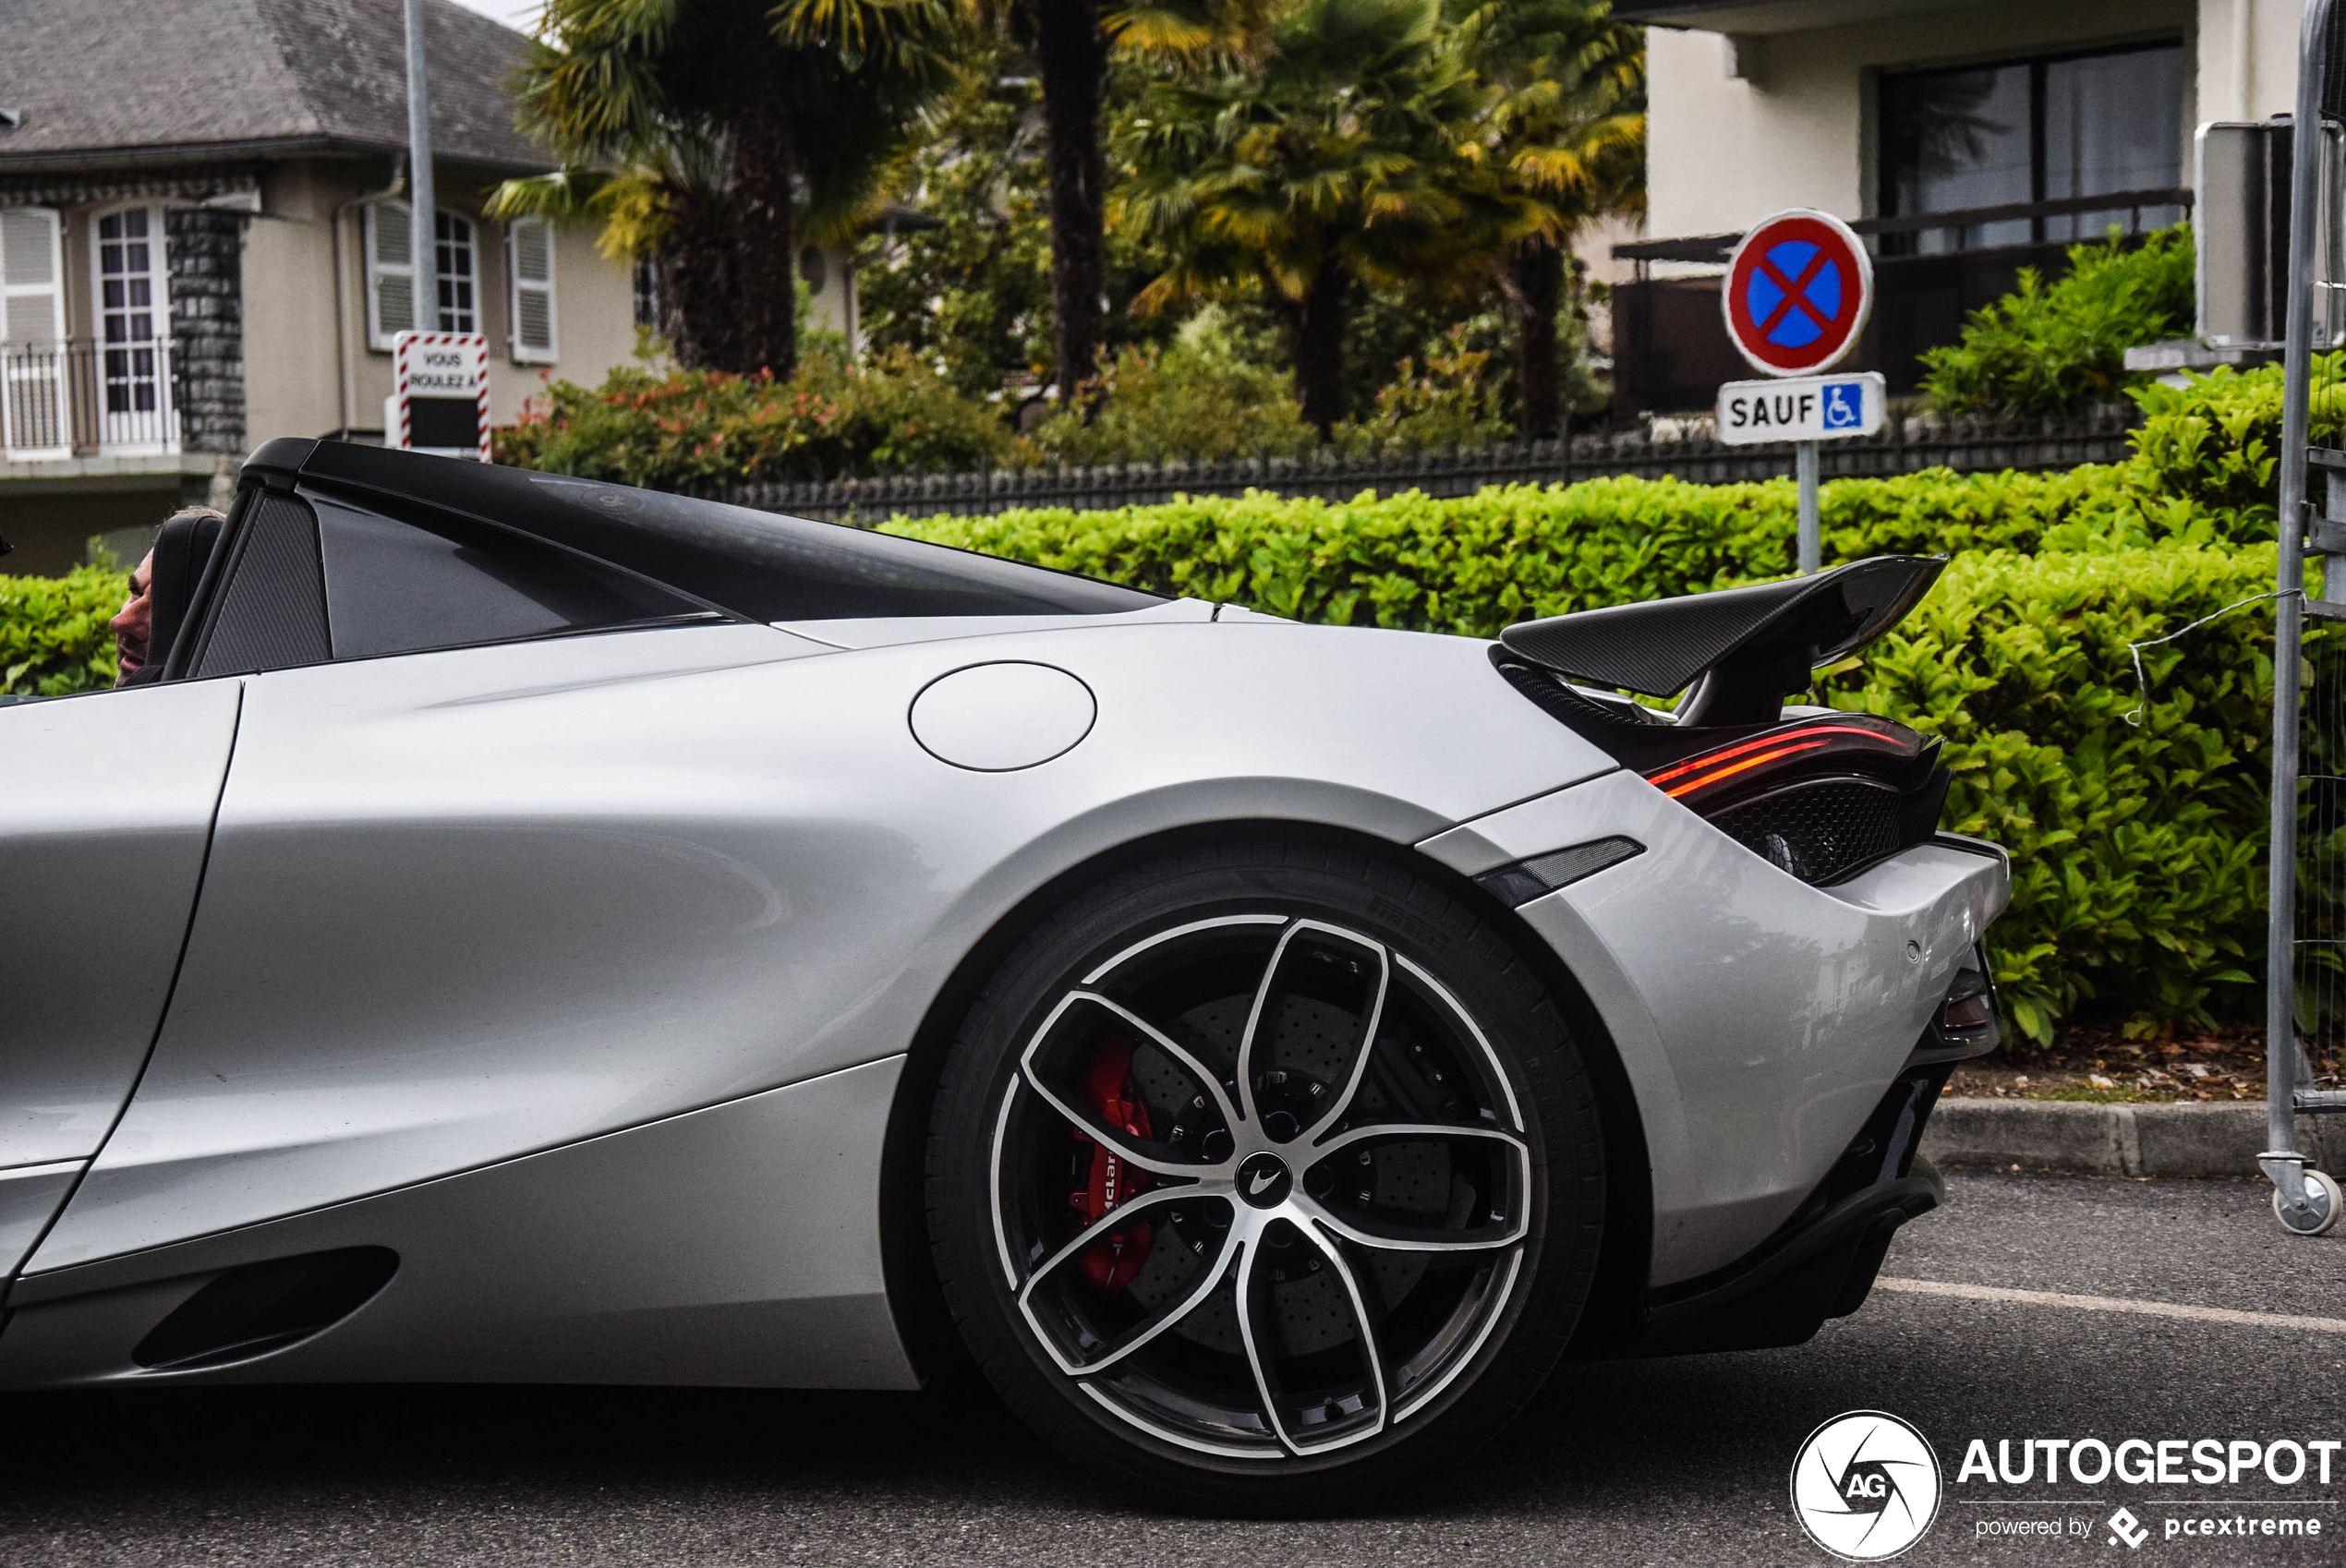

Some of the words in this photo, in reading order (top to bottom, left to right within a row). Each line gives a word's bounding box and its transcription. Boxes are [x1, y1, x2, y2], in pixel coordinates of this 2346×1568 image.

[424, 352, 462, 368] VOUS
[409, 373, 465, 389] ROULEZ
[1730, 394, 1815, 428] SAUF
